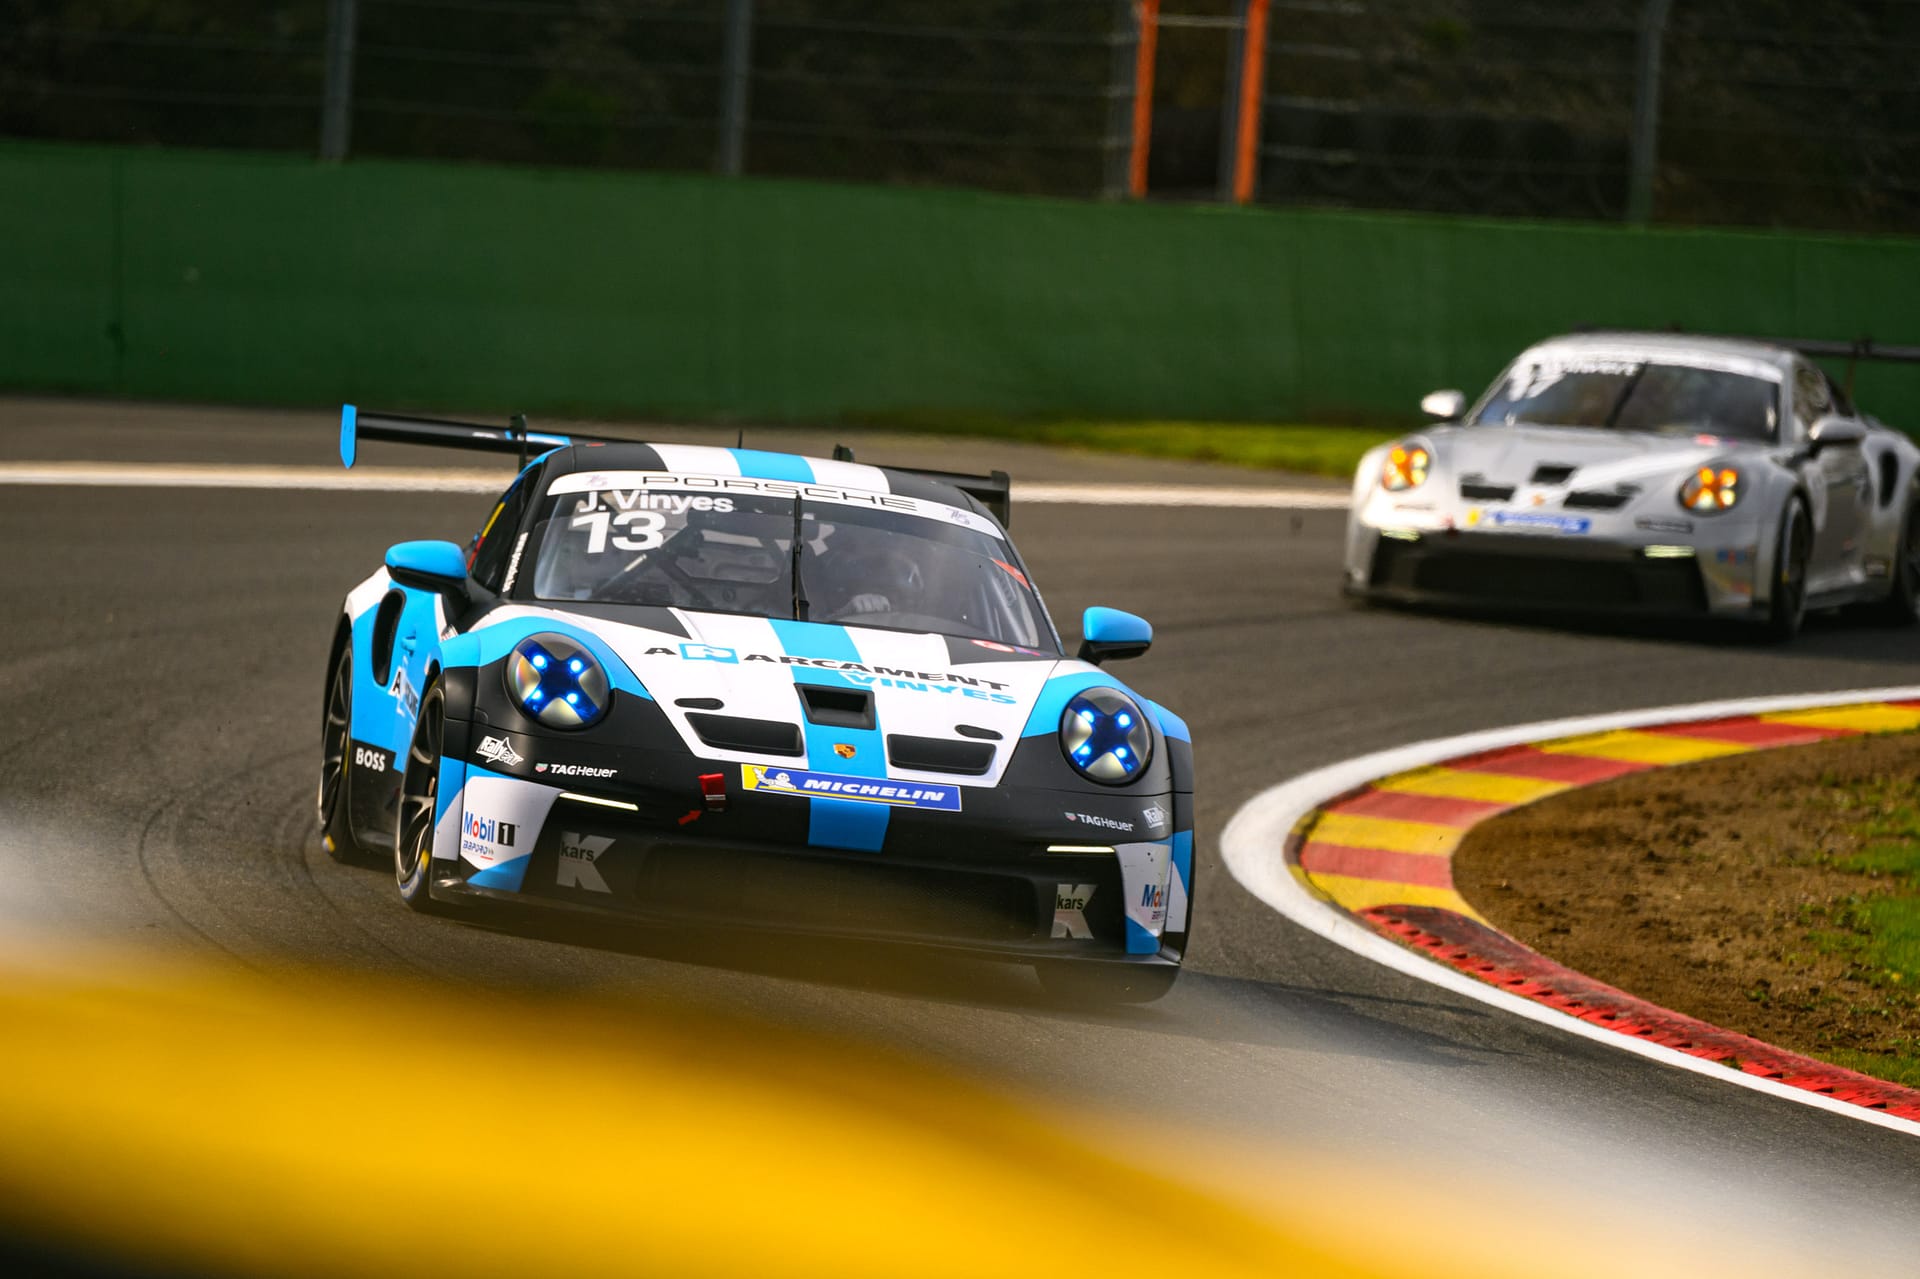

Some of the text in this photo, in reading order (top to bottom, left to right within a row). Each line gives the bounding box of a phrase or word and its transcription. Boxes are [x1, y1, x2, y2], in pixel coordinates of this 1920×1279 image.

[579, 489, 734, 515] J. Vinyes
[642, 475, 918, 512] PORSCHE
[572, 510, 666, 554] 13
[843, 672, 1017, 705] VINYES
[355, 746, 386, 772] BOSS
[803, 779, 945, 802] MICHELIN
[463, 811, 496, 843] Mobil
[561, 842, 595, 861] kars
[1057, 894, 1084, 910] kars
